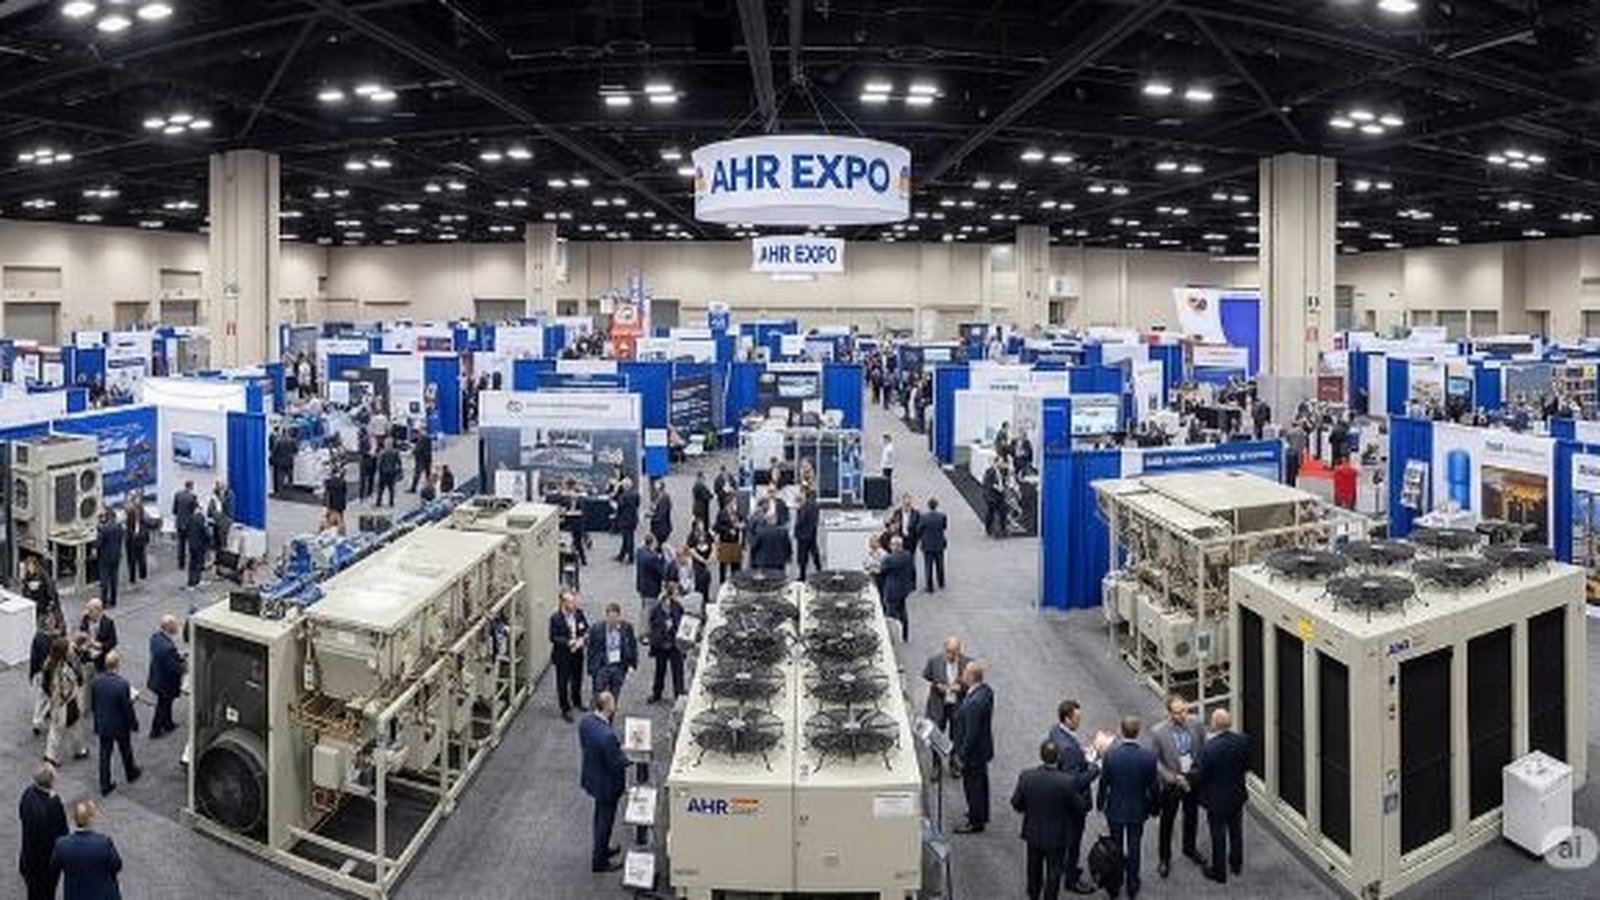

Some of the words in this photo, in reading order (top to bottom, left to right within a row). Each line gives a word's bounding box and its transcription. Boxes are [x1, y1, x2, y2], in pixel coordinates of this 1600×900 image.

[711, 155, 781, 195] AHR
[792, 154, 890, 193] EXPO
[759, 245, 791, 264] AHR
[794, 245, 836, 264] EXPO
[687, 797, 729, 815] AHR
